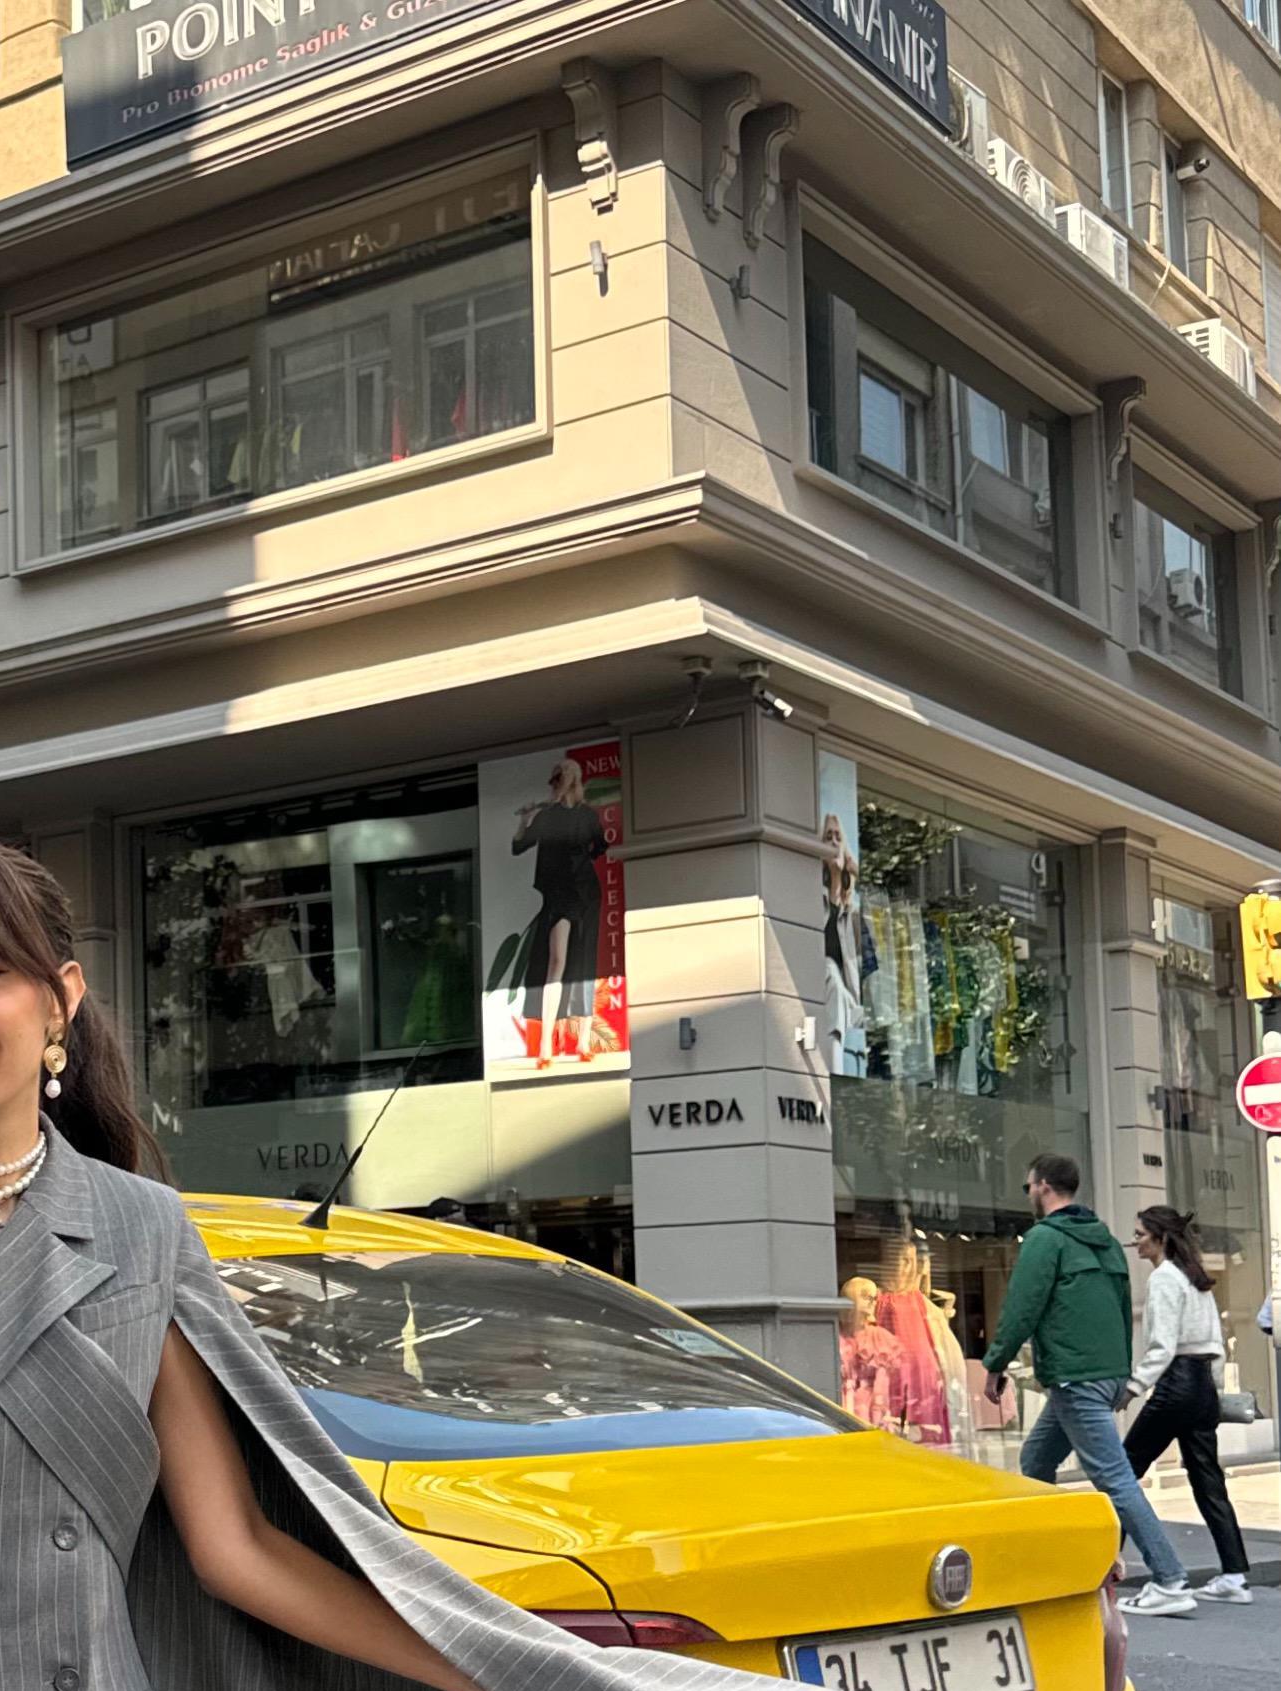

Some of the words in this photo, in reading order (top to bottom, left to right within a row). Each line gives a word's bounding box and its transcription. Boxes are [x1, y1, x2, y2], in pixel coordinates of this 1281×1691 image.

[122, 101, 160, 124] Pro
[168, 56, 269, 104] Bionome
[275, 22, 351, 65] Sağlık
[359, 14, 378, 32] &
[136, 0, 320, 80] POIN
[586, 755, 620, 774] NEW
[648, 1098, 744, 1127] VERDA
[986, 1626, 1026, 1687] 31
